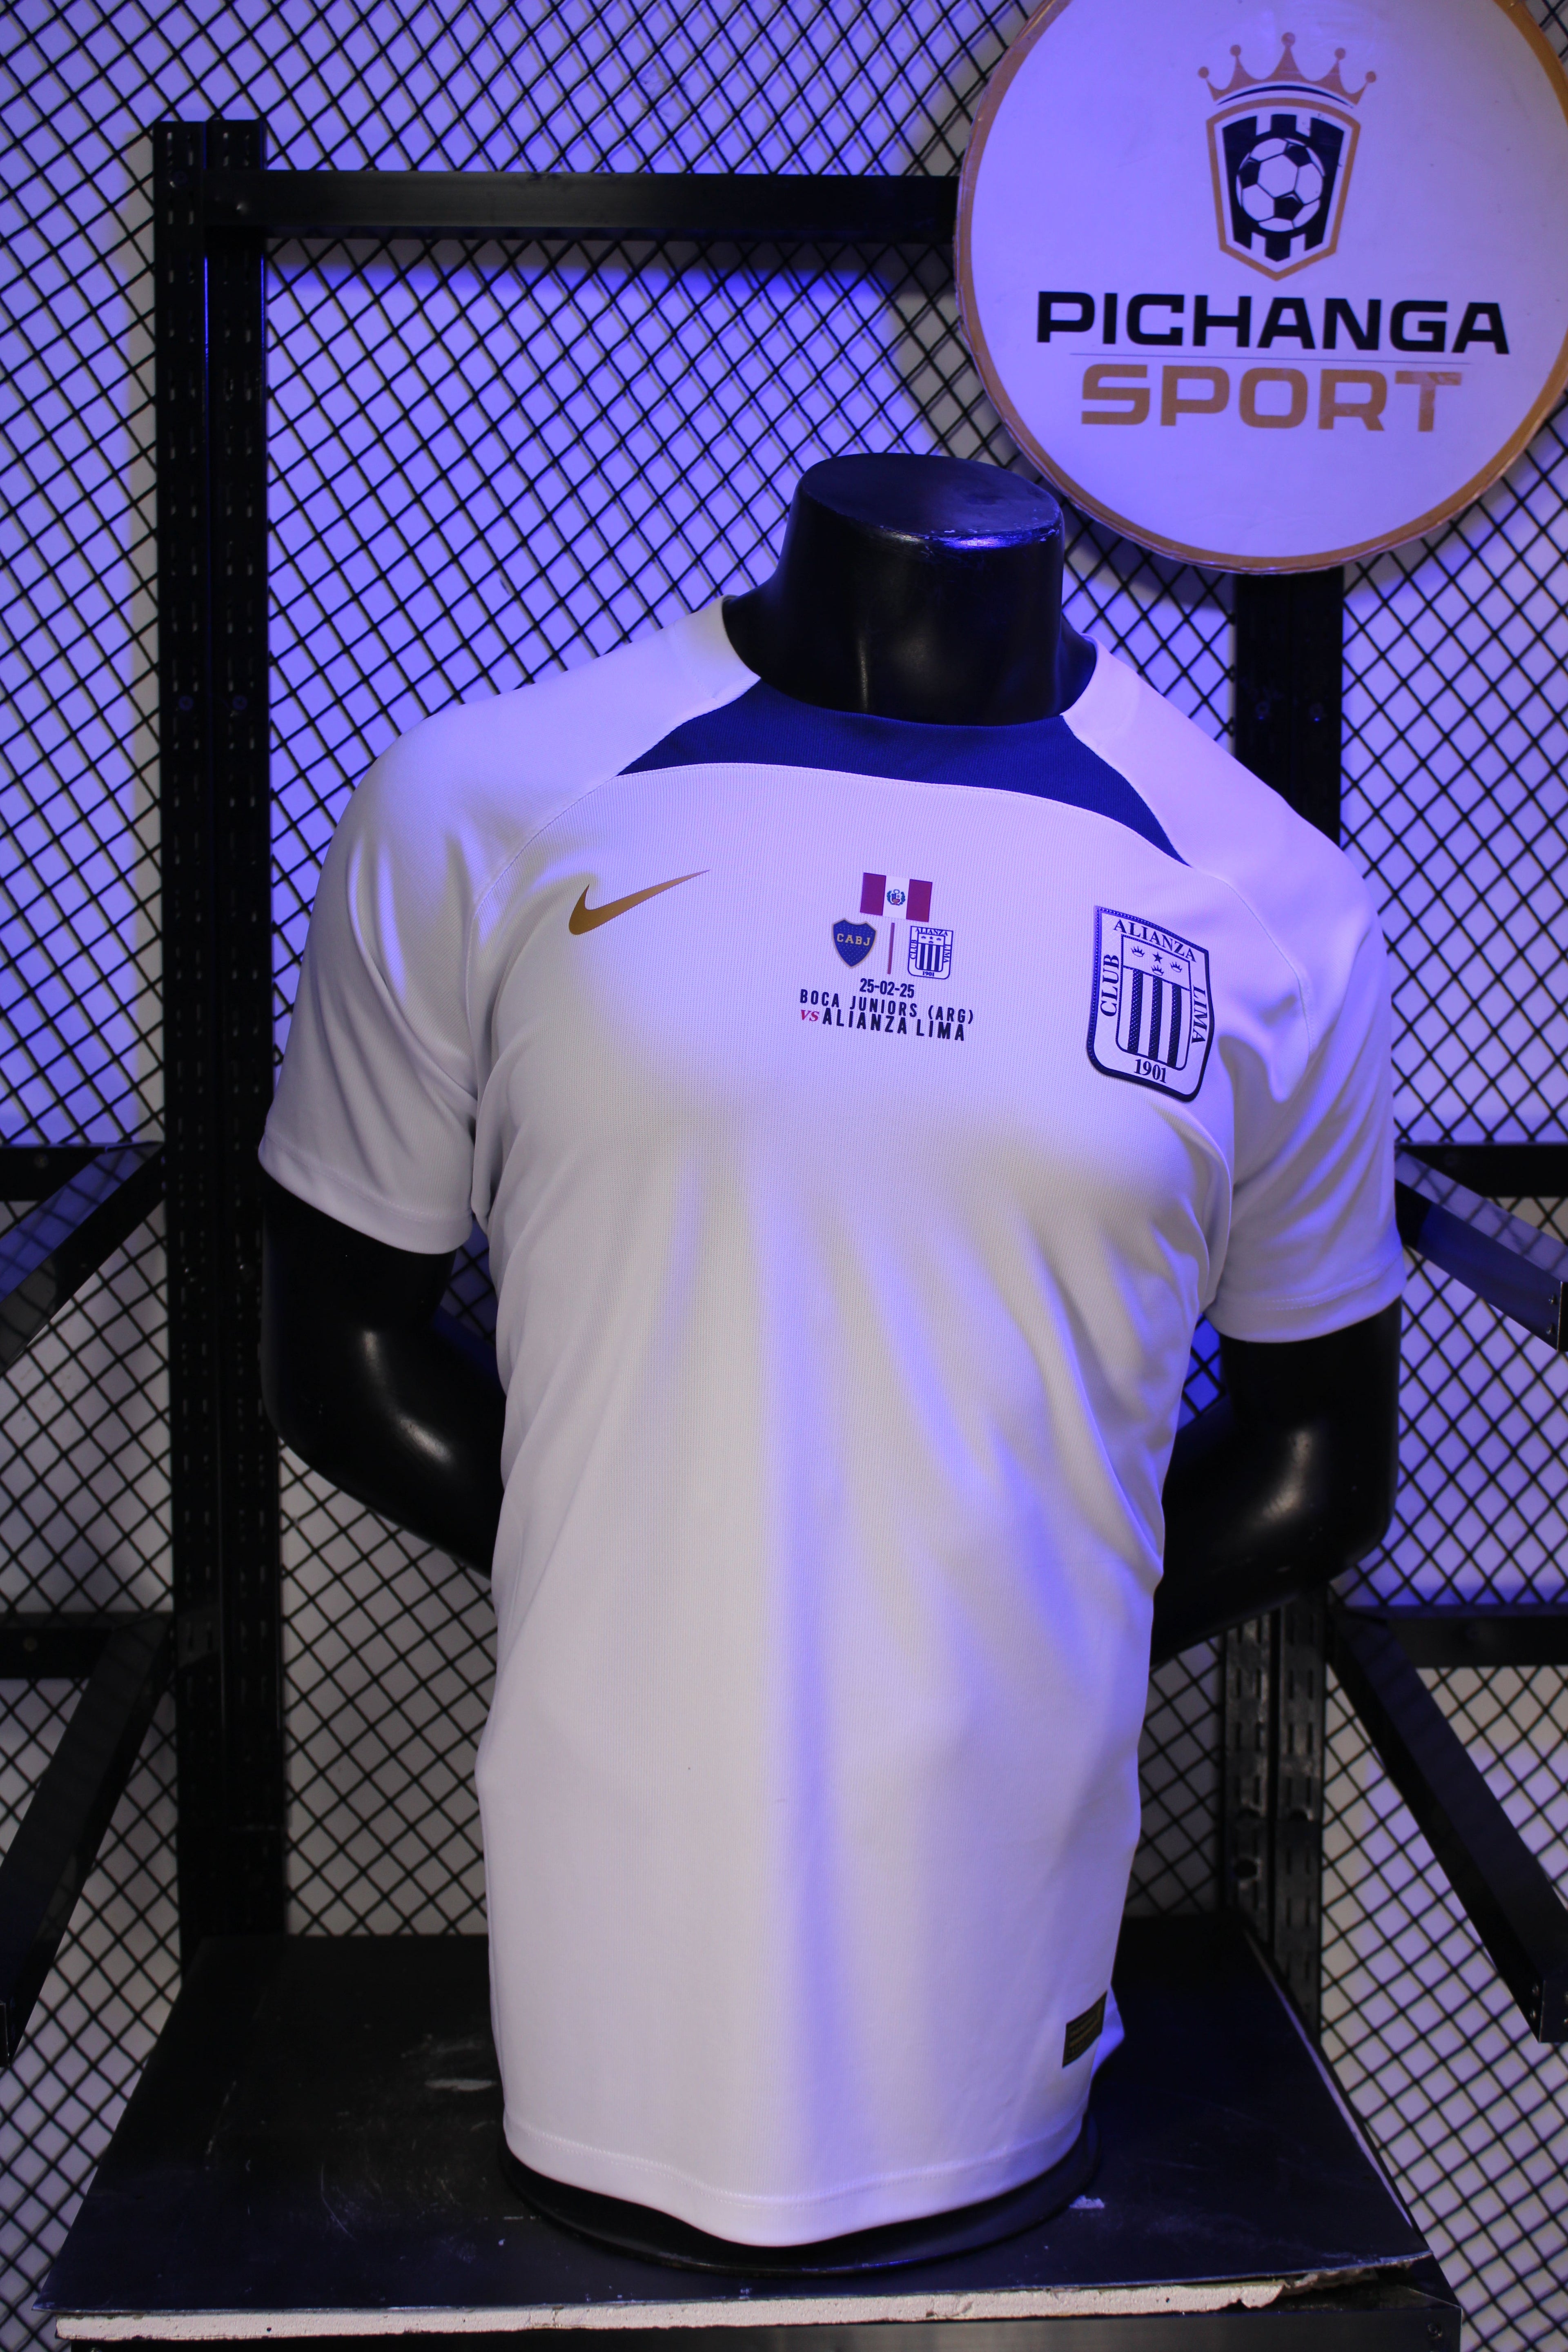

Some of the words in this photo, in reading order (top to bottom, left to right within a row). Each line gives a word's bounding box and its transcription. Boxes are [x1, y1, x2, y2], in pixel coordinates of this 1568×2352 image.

[1036, 291, 1510, 354] PICHANGA
[1081, 363, 1462, 432] SPORT
[837, 933, 871, 947] CABJ
[915, 927, 948, 937] ALIANZA
[1113, 919, 1196, 963] ALIANZA
[860, 978, 915, 998] 25-02-25
[1100, 954, 1119, 1017] CLUB
[800, 989, 840, 1008] BOCA
[850, 996, 917, 1017] JUNIORS
[928, 1005, 974, 1024] (ARG)
[1192, 984, 1207, 1044] LIMA
[800, 1009, 819, 1022] VS
[822, 1008, 907, 1034] ALIANZA
[916, 1019, 964, 1041] LIMA
[1134, 1059, 1167, 1084] 1901
